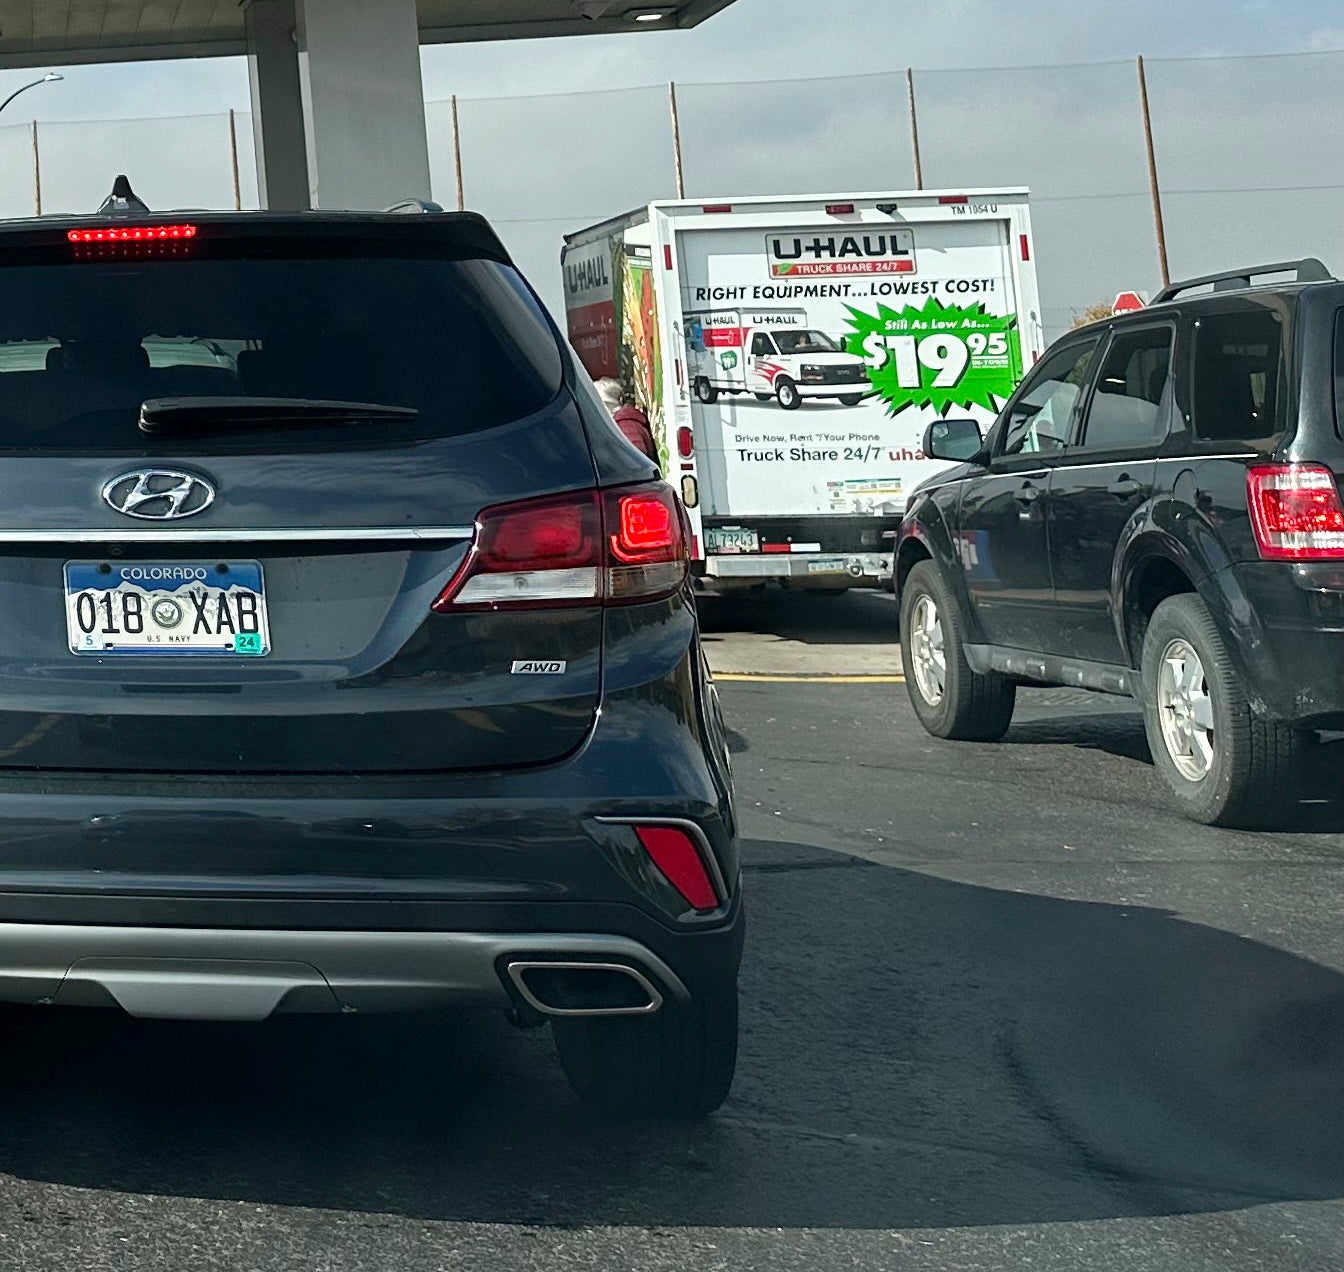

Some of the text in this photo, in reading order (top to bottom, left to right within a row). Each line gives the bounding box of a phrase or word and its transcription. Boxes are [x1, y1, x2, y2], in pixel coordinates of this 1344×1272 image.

[950, 205, 966, 215] TM
[772, 234, 909, 259] U-HAUL
[796, 262, 899, 274] TRUCK SHARE 24/7
[696, 284, 745, 301] RIGHT
[945, 279, 995, 293] COST!
[752, 315, 799, 324] U-HAUL
[884, 319, 908, 331] Still
[911, 320, 928, 330] As
[930, 319, 959, 329] Low
[735, 434, 760, 443] Drive
[848, 433, 881, 441] Phone
[737, 448, 785, 462] Truck
[789, 447, 839, 462] Share
[120, 567, 207, 580] COLORADO
[76, 591, 259, 635] 018 XAB
[85, 634, 94, 646] 5
[168, 635, 191, 643] NAVY
[238, 636, 256, 648] 24
[518, 662, 561, 673] AWD
